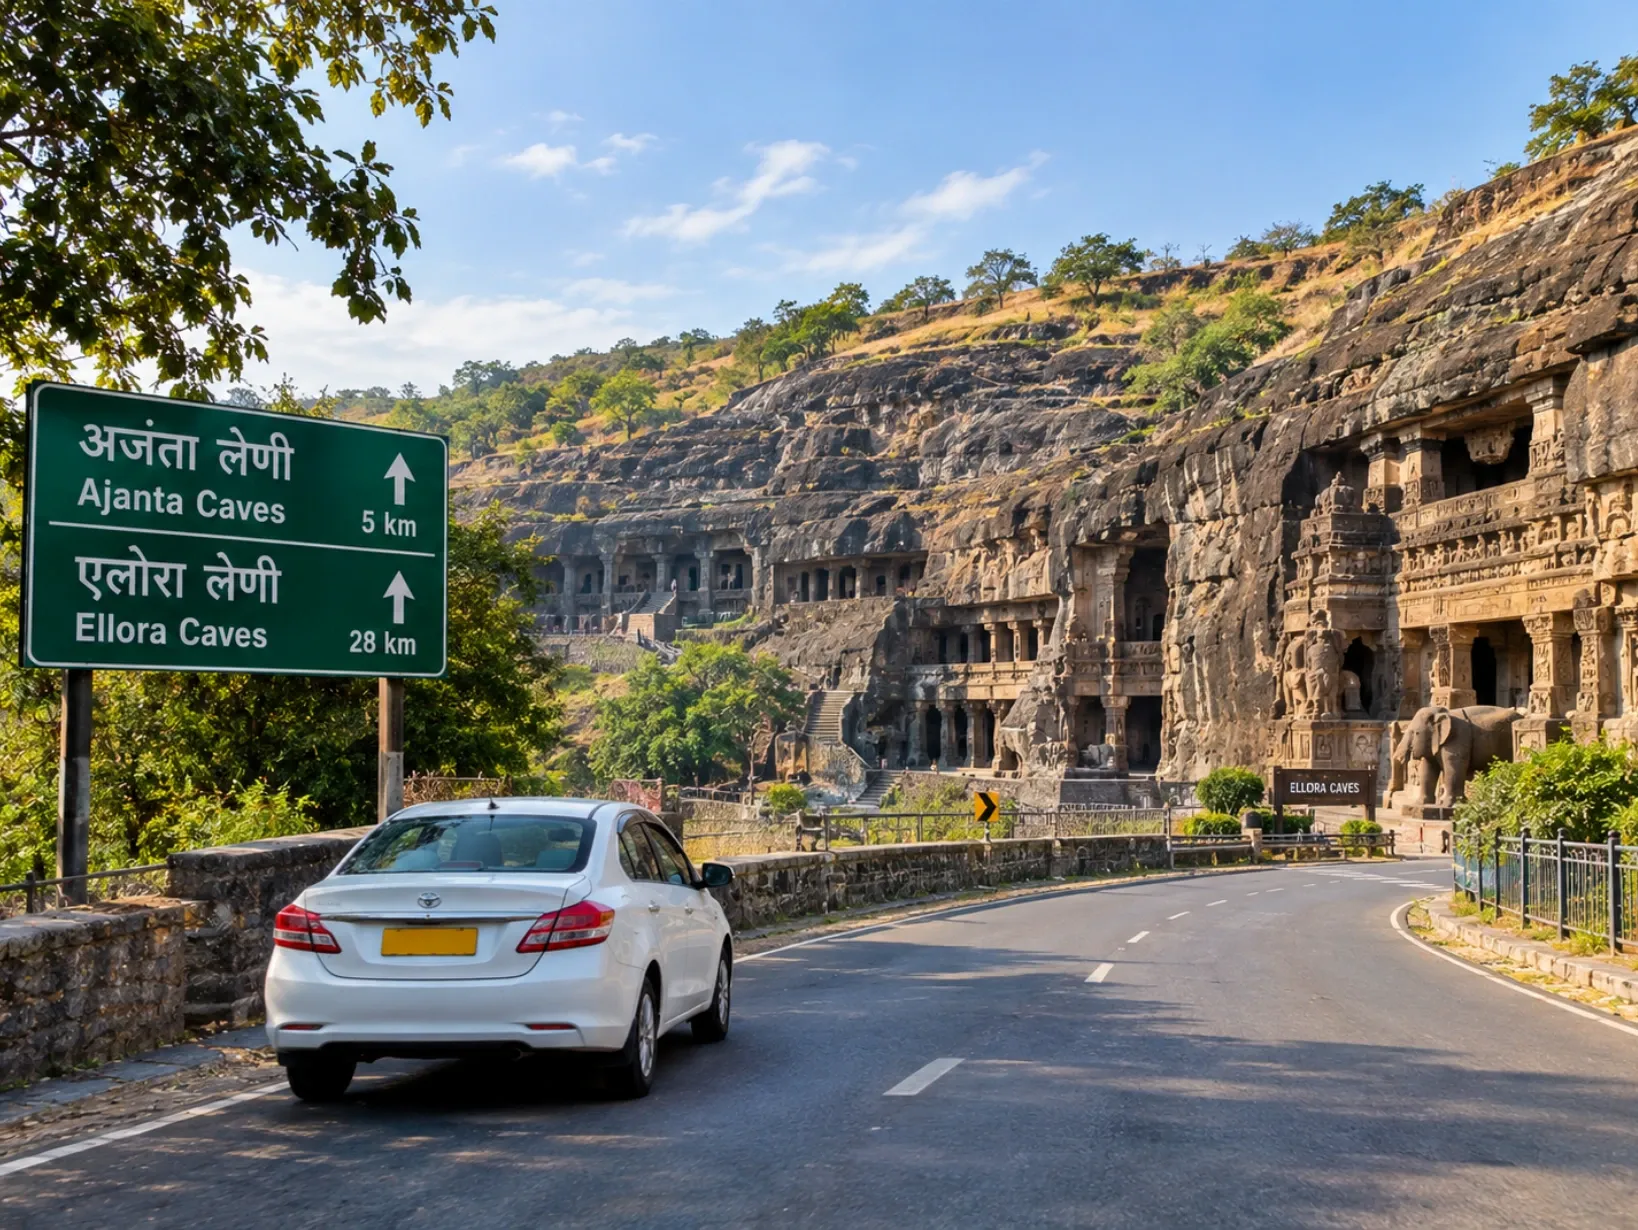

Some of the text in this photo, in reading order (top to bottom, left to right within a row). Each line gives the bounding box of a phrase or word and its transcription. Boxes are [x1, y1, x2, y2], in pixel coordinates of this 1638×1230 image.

[79, 419, 295, 481] अजंता लेणी
[77, 477, 285, 524] Ajanta Caves
[362, 510, 416, 537] 5 km
[74, 545, 282, 604] एलोरा लेणी
[76, 612, 267, 648] Ellora Caves
[349, 629, 416, 655] 28 km
[1290, 782, 1360, 793] ELLORA CAVES
